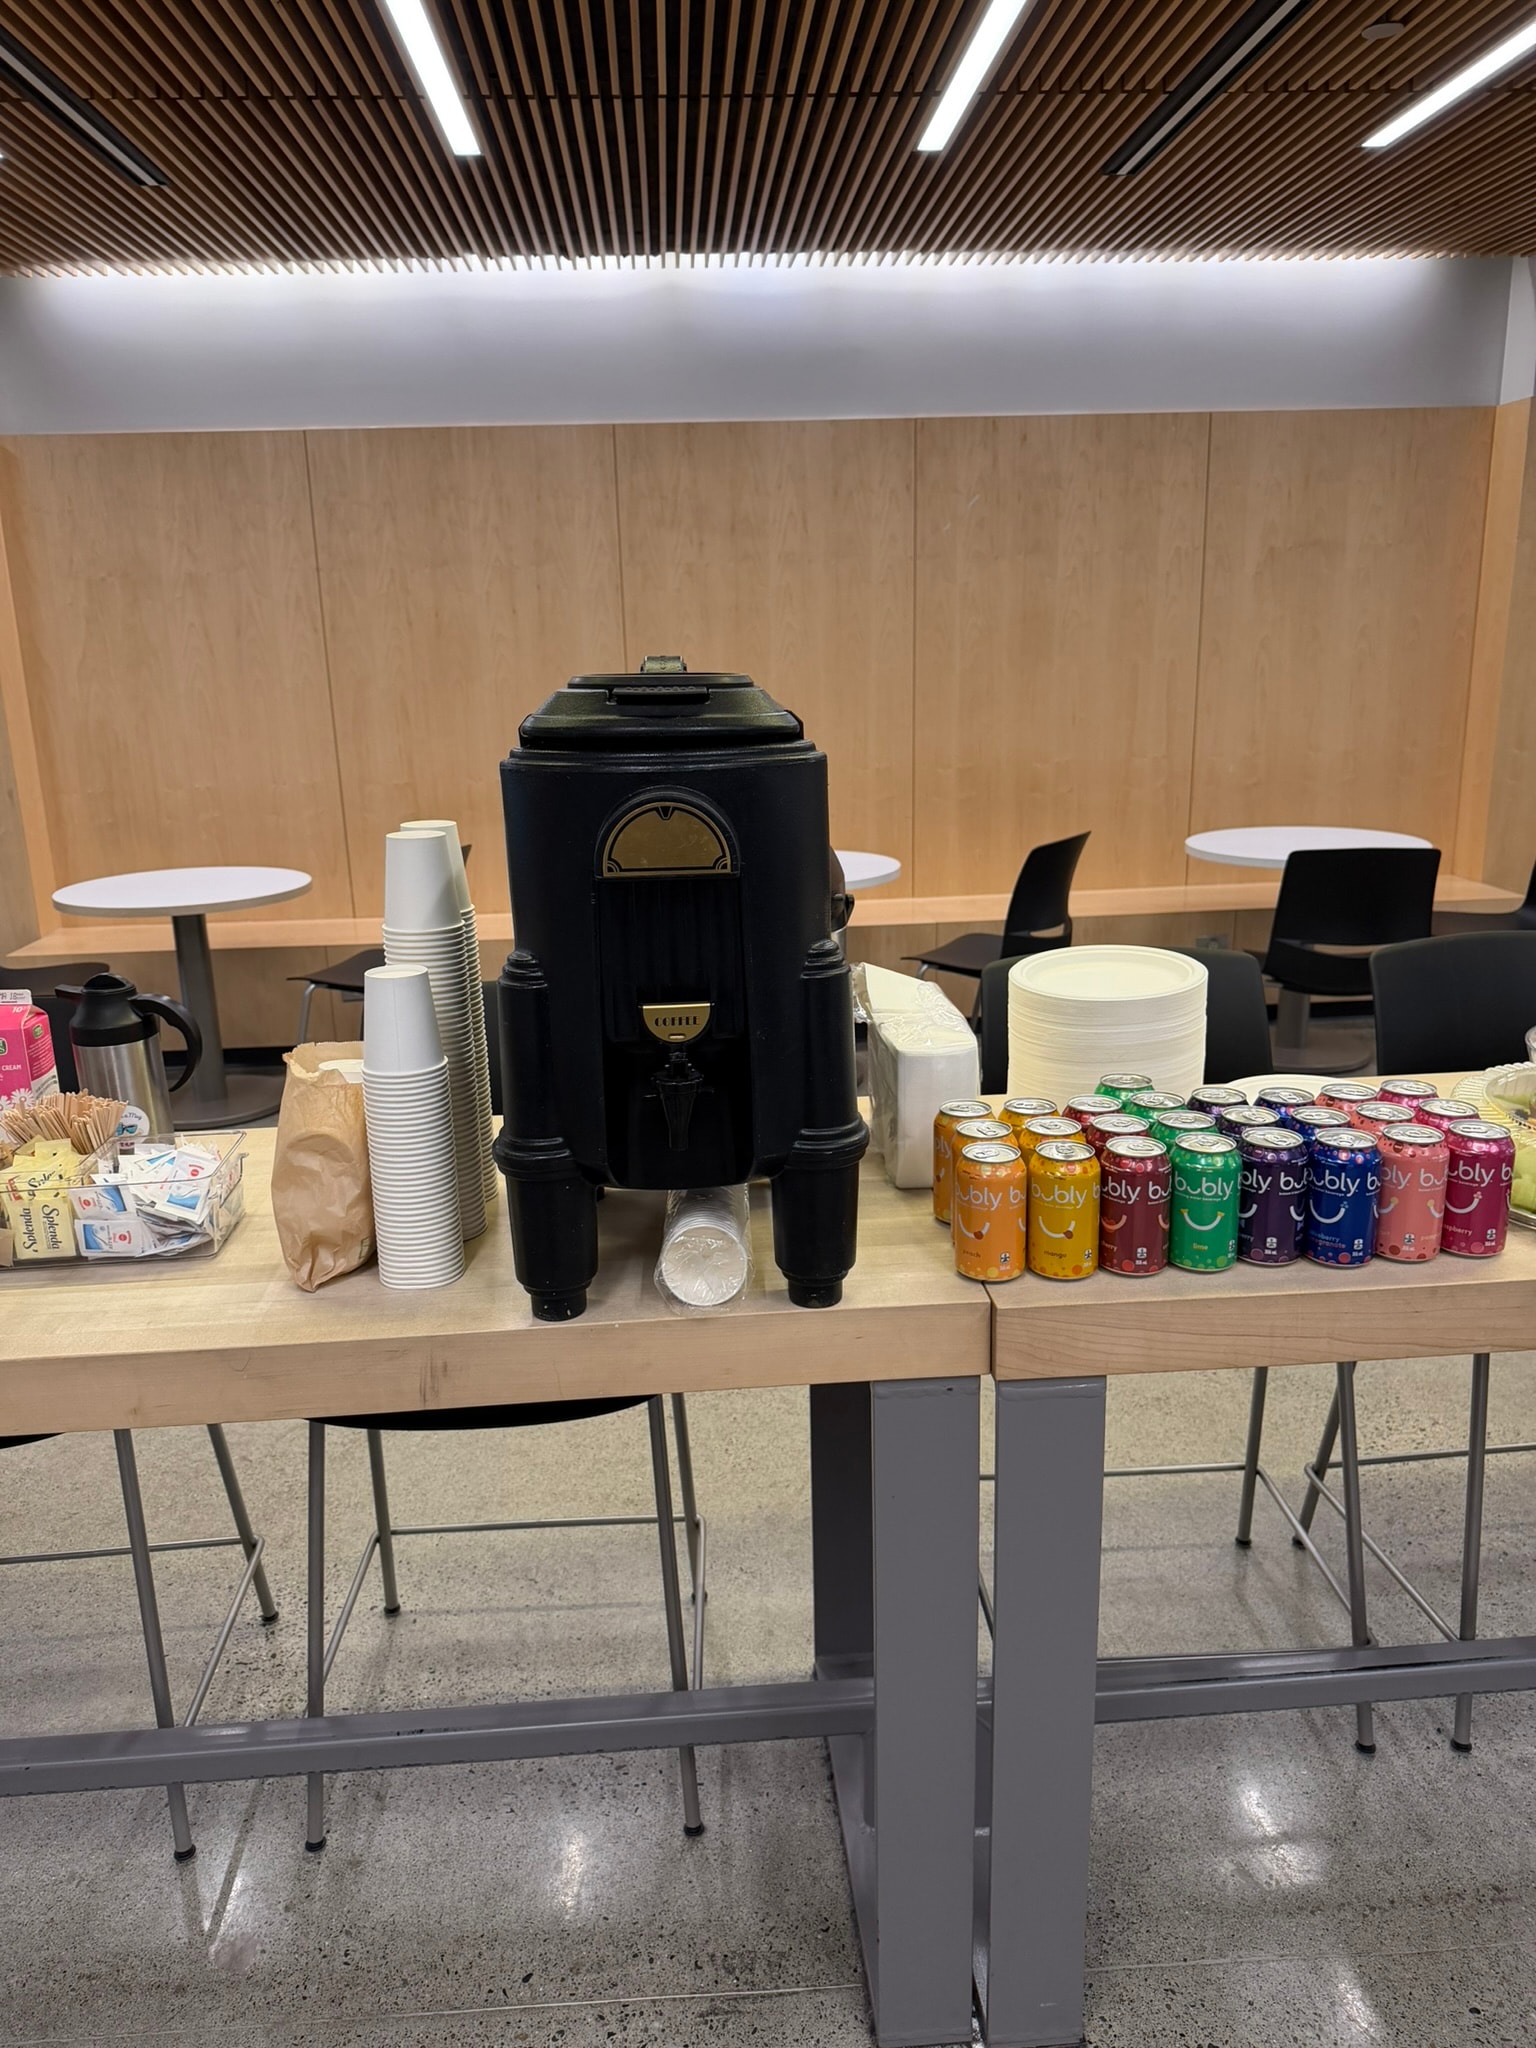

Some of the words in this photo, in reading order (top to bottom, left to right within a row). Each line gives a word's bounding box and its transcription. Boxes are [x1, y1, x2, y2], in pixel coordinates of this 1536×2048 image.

[654, 1016, 700, 1026] COFFEE
[1031, 1177, 1087, 1209] bubly
[1174, 1170, 1234, 1201] bubly
[20, 1207, 38, 1253] Splenda
[42, 1204, 62, 1250] Splenda
[1043, 1250, 1068, 1260] mango
